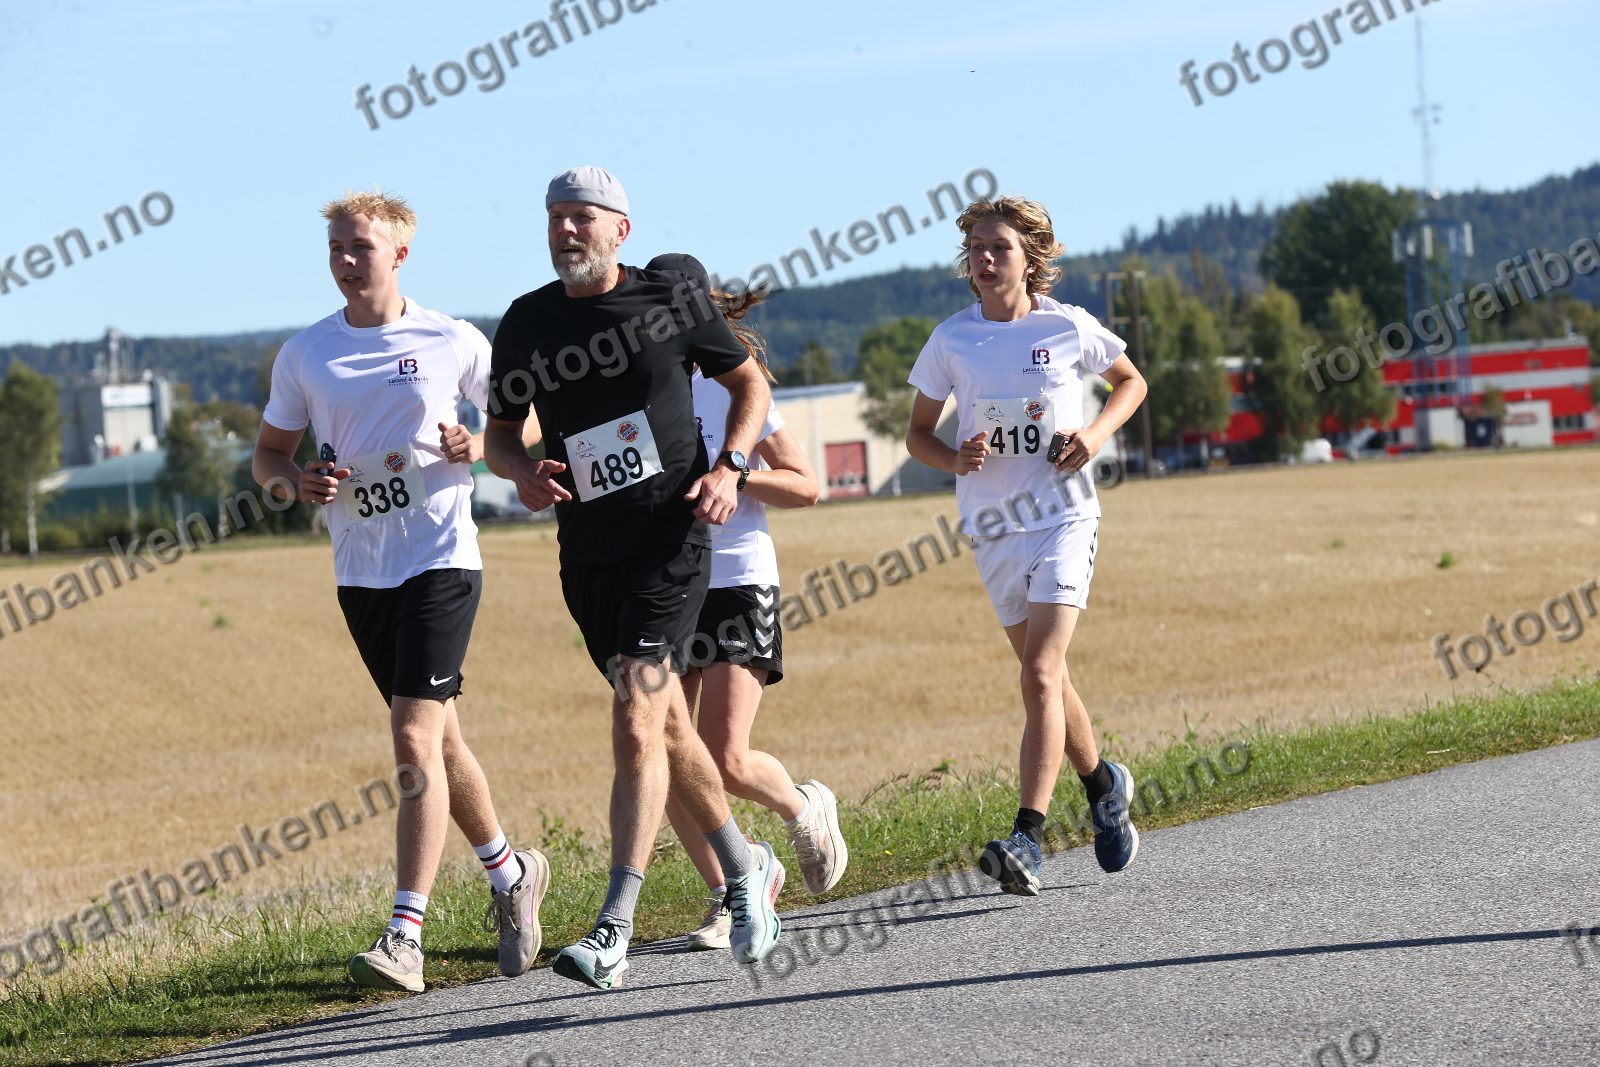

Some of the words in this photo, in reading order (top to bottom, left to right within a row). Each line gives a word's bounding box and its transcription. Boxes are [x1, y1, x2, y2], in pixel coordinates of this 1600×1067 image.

[990, 424, 1040, 455] 419
[591, 446, 644, 491] 489
[354, 477, 410, 518] 338
[718, 638, 748, 649] hummel
